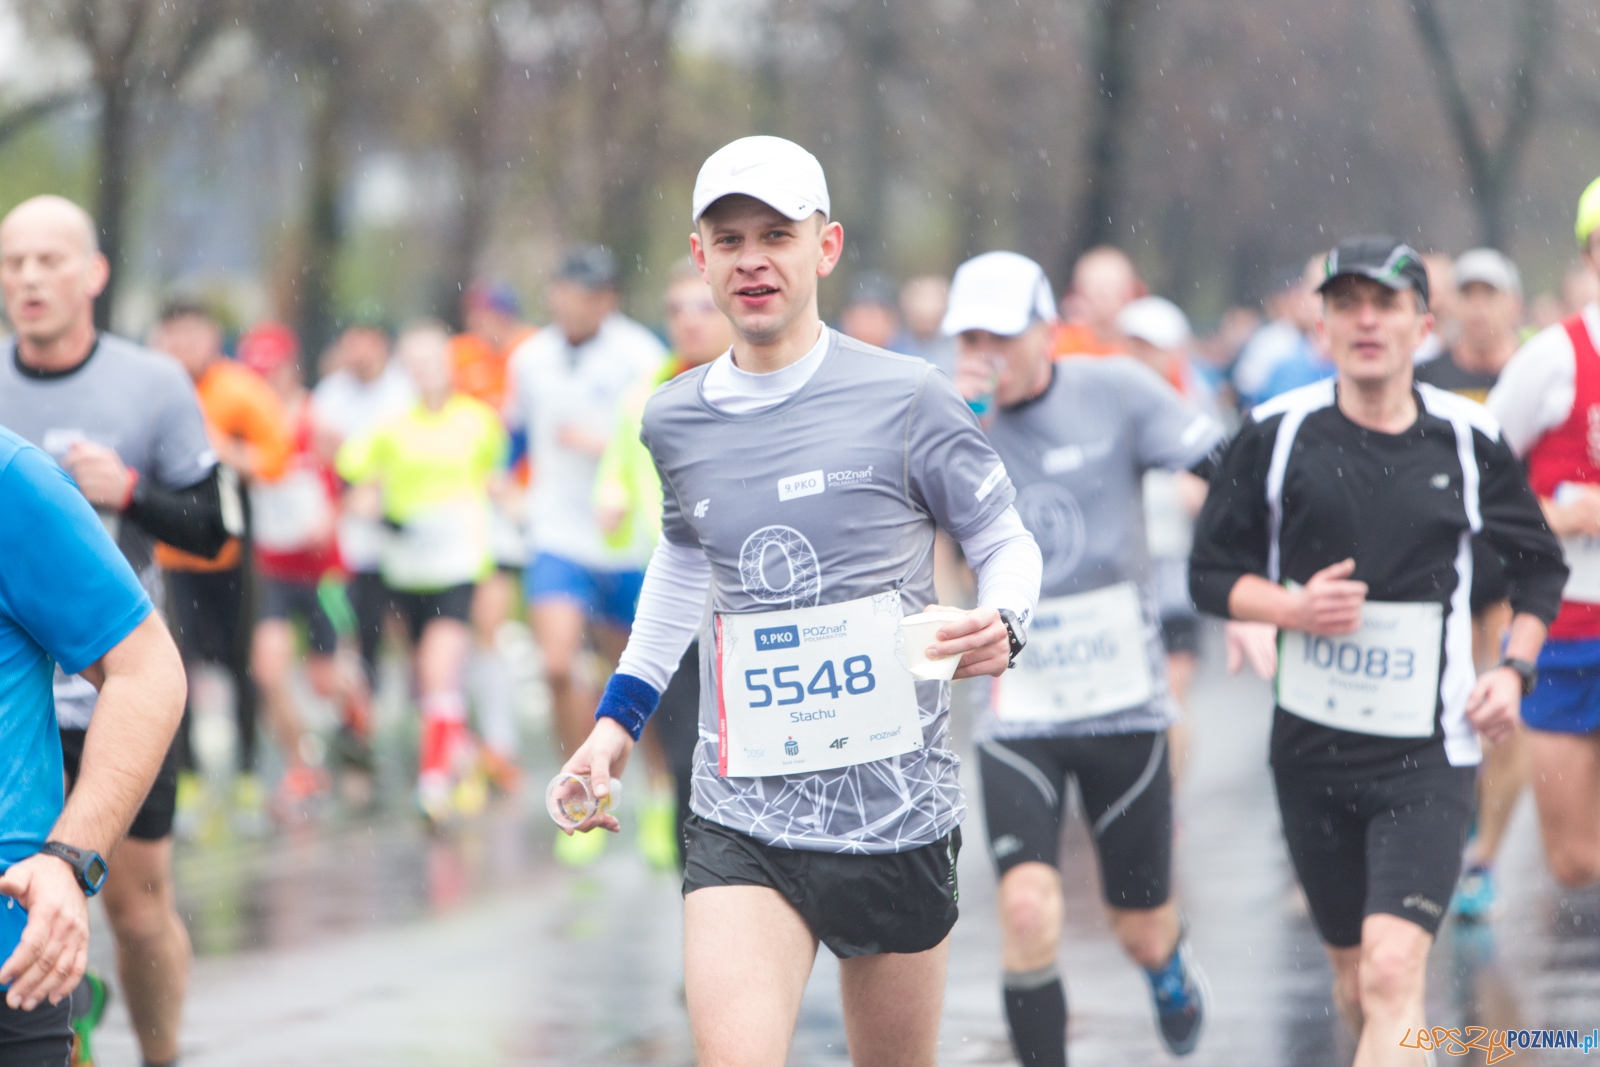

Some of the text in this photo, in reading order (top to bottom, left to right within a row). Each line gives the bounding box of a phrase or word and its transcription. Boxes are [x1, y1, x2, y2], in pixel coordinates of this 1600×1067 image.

[693, 498, 711, 519] 4F
[1302, 632, 1415, 681] 10083
[744, 654, 876, 708] 5548
[789, 708, 836, 723] Stachu
[828, 736, 849, 749] 4F
